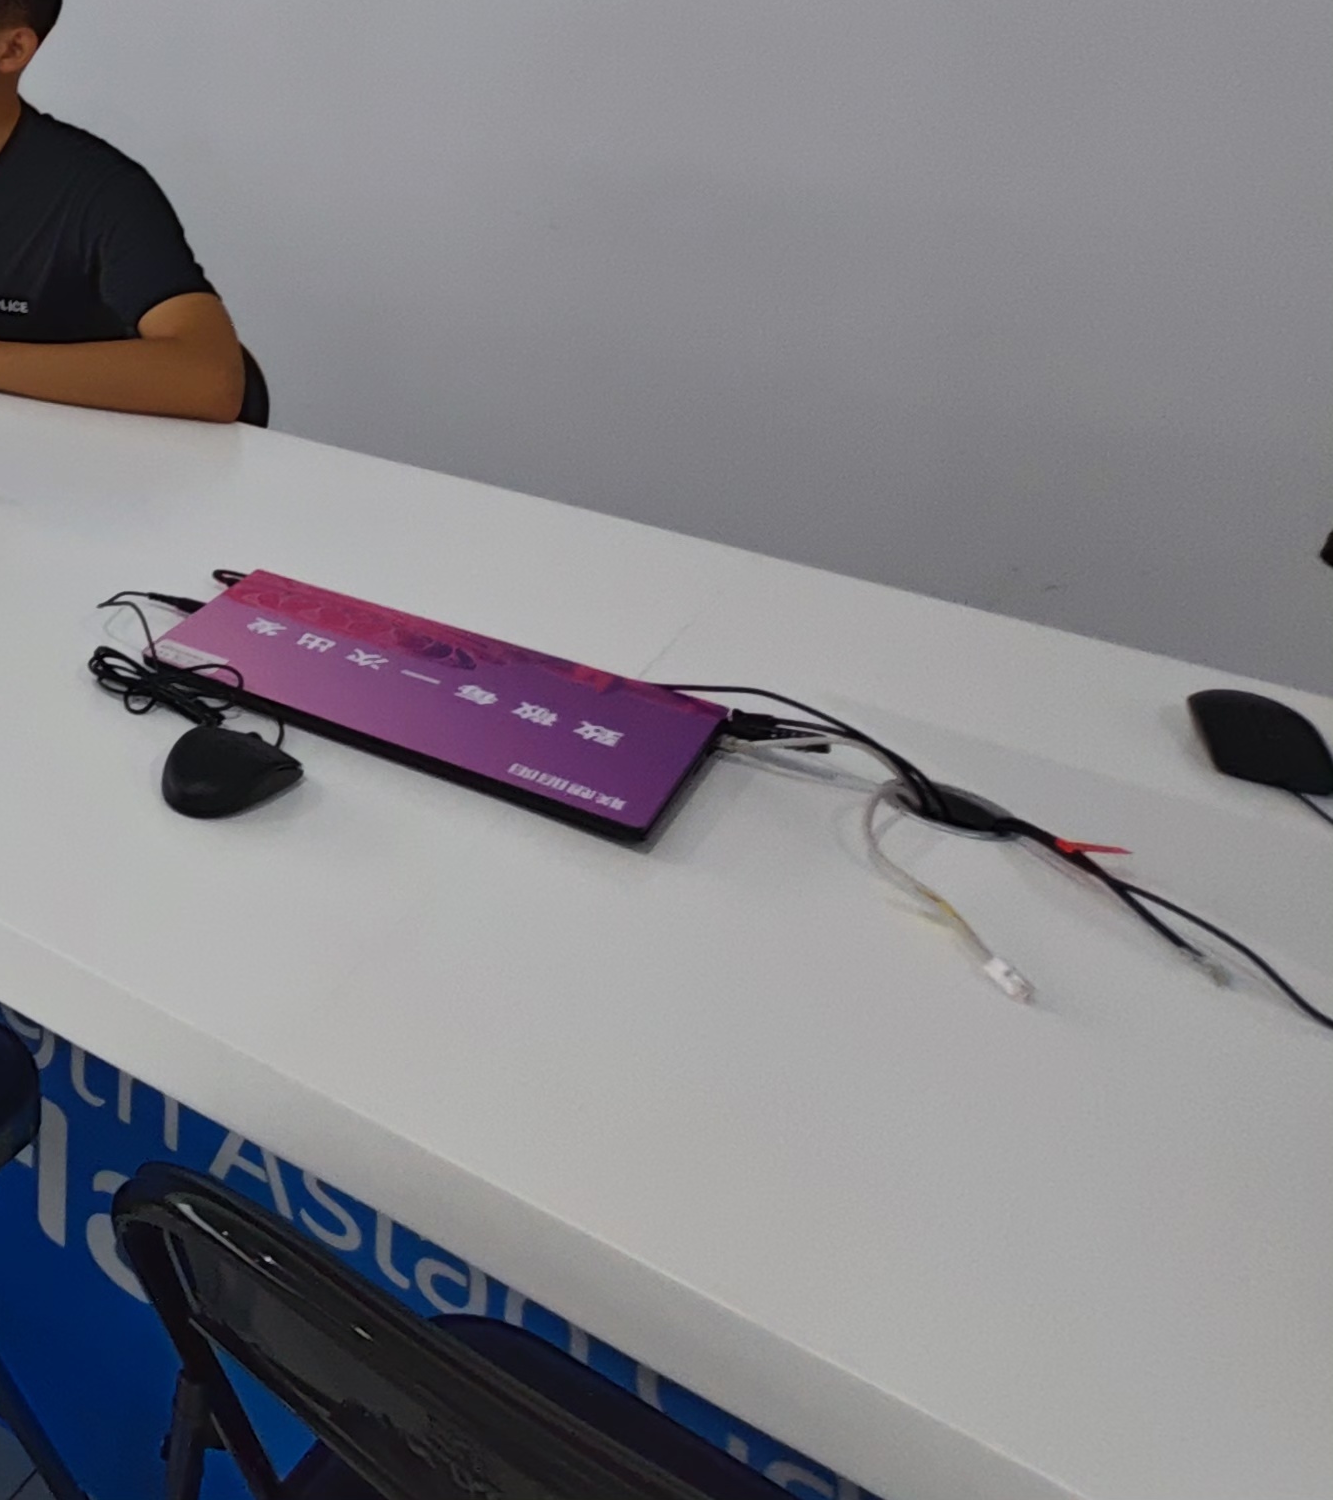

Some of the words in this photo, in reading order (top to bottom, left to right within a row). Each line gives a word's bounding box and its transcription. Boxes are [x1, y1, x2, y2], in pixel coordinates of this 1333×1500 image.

[245, 615, 626, 749] 致敬每一次出发
